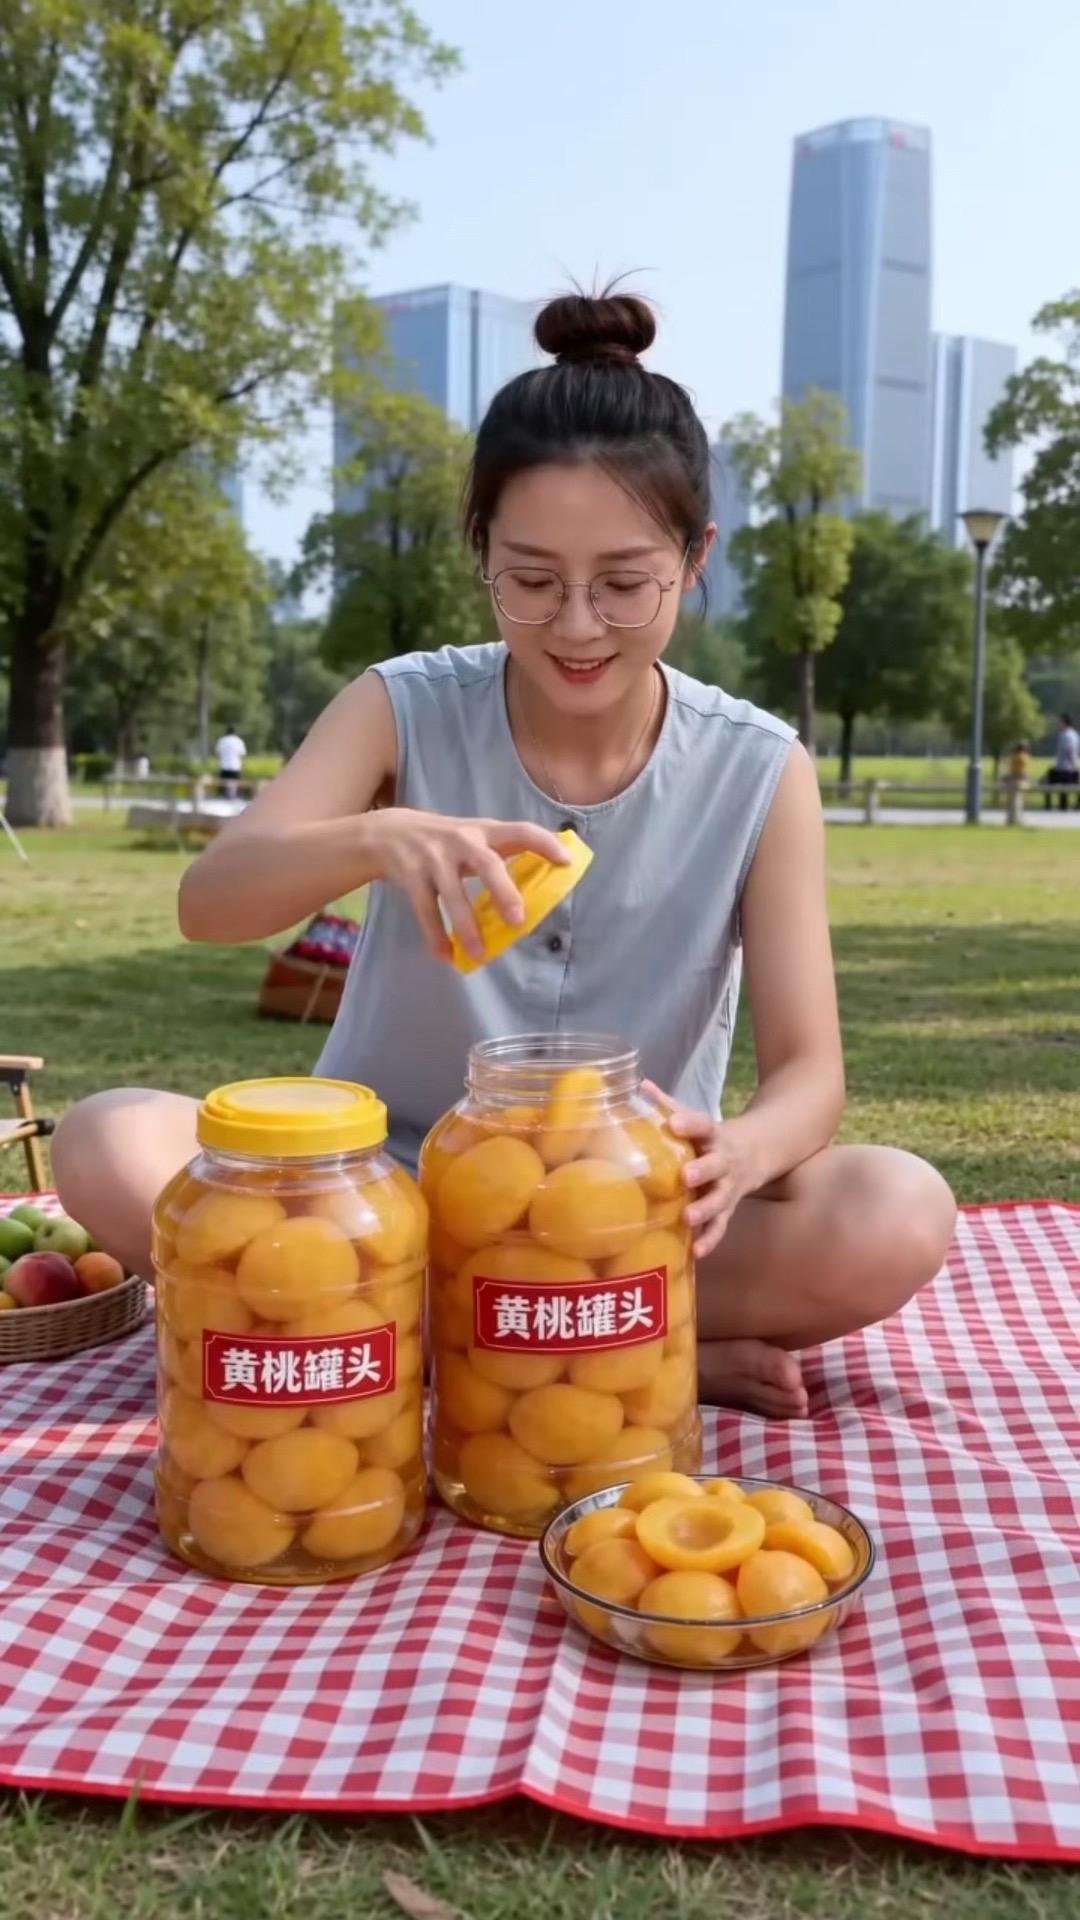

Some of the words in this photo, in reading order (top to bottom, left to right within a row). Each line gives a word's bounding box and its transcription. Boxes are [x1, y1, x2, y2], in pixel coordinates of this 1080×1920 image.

[493, 1287, 654, 1340] 黄桃罐头
[220, 1343, 382, 1394] 黄桃罐头
